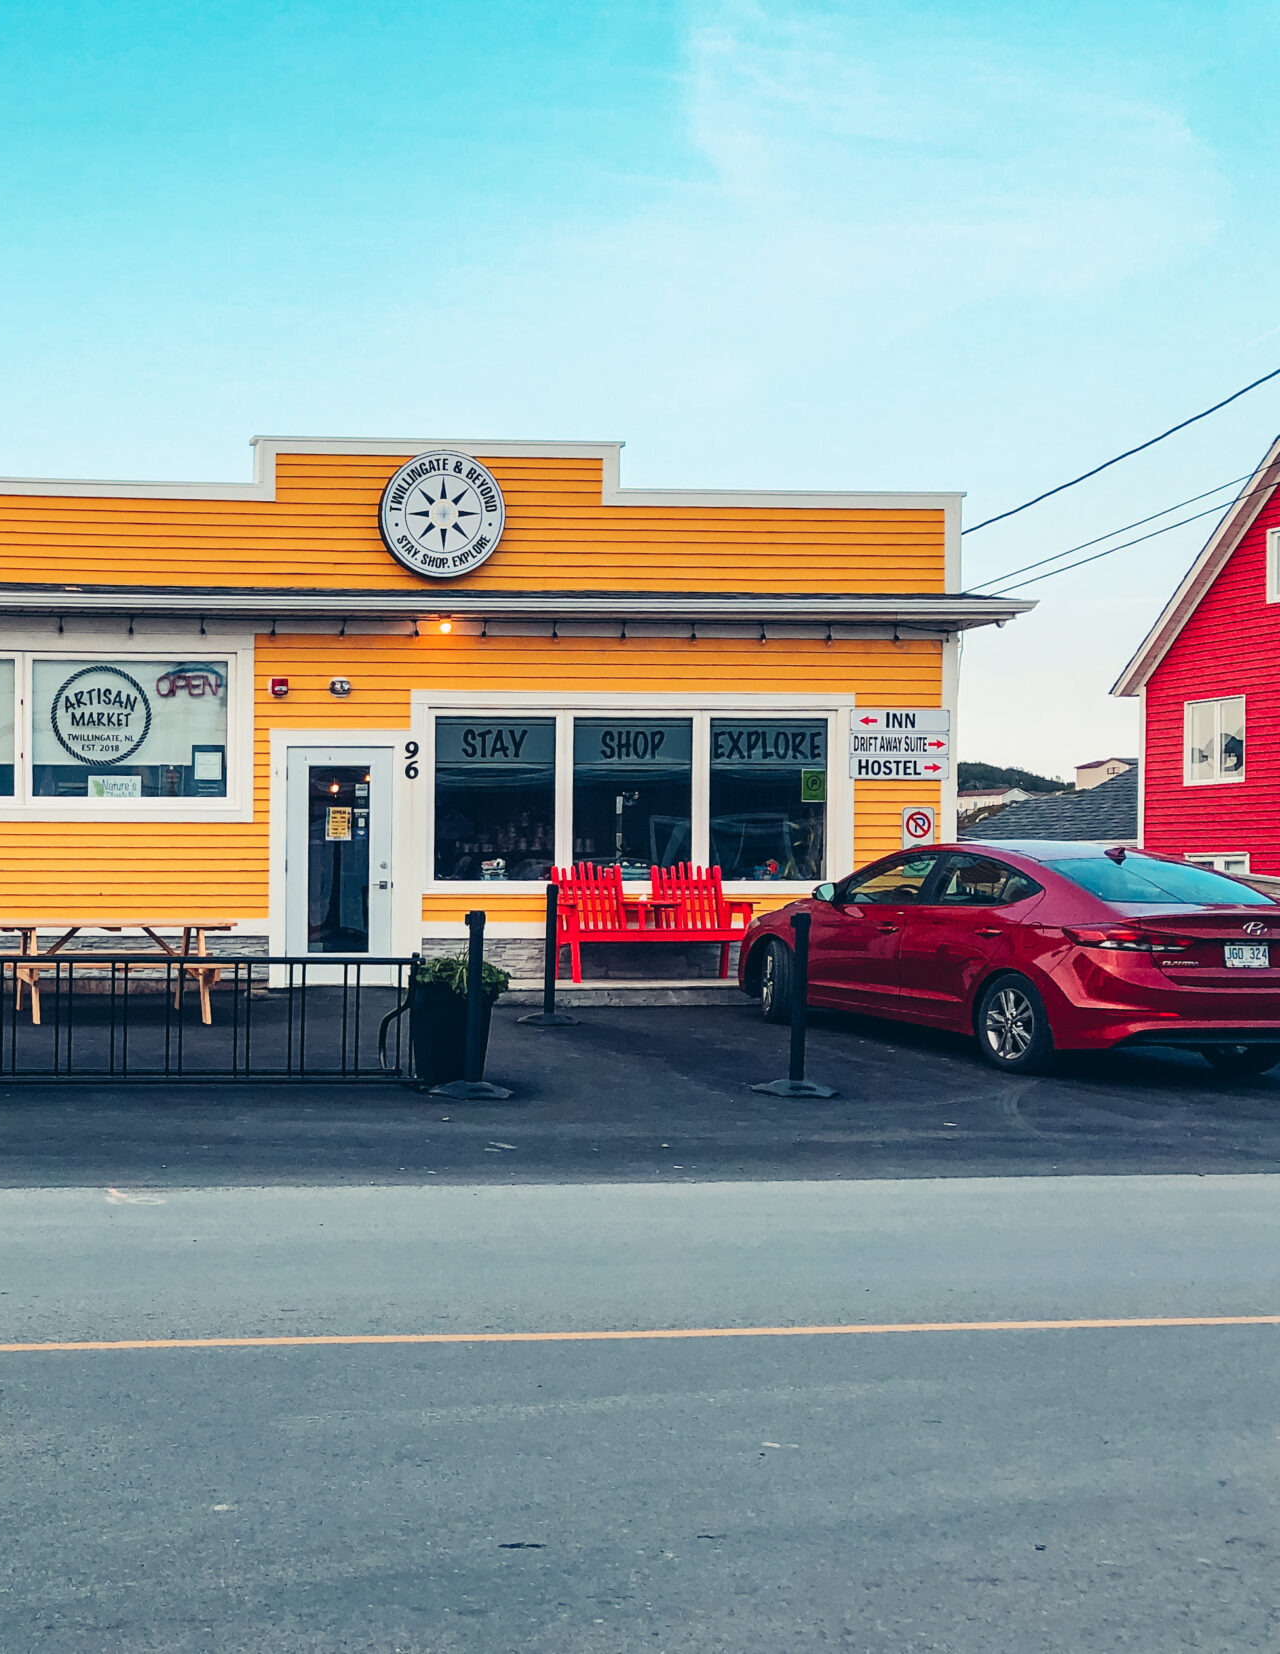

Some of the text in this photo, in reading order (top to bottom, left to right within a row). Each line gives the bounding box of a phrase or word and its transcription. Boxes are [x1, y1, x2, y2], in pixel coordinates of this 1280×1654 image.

[389, 458, 498, 513] TWILLINGATE & BEYOND
[396, 534, 491, 569] STAY. SHOP. EXPLORE
[156, 674, 219, 697] OPEN
[64, 687, 138, 713] ARTISAN
[70, 711, 133, 728] MARKET
[885, 711, 916, 729] INN
[67, 733, 134, 743] TWILLINGATE, NL
[461, 728, 528, 759] STAY
[600, 729, 665, 760] SHOP
[713, 730, 823, 760] EXPLORE
[853, 735, 928, 753] DRIFT AWAY SUITE
[81, 744, 120, 752] EST. 2018
[857, 758, 922, 776] HOSTEL
[101, 778, 137, 791] Nature's
[1249, 948, 1267, 960] 324
